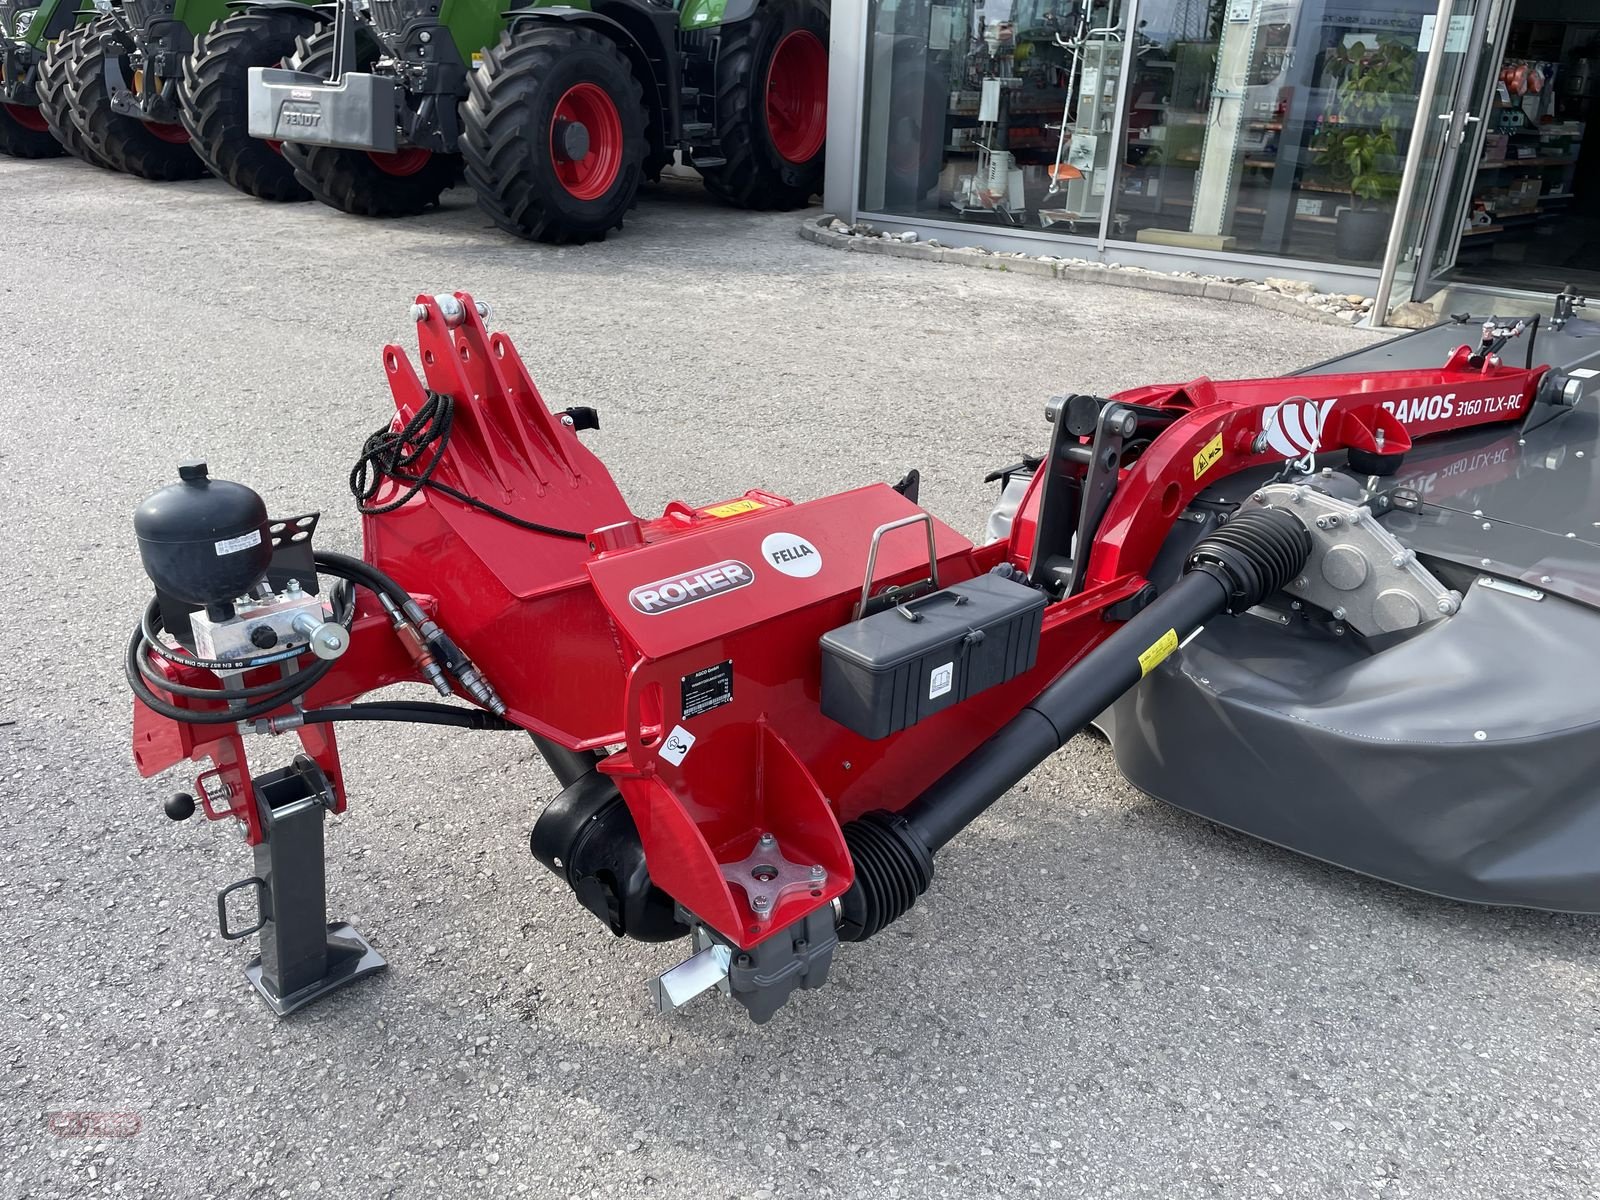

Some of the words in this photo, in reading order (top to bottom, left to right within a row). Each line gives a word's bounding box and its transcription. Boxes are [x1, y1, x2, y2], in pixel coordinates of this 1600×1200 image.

[283, 111, 321, 127] FENDT
[1456, 400, 1482, 417] 3160
[1484, 393, 1523, 413] TLX-RC
[771, 544, 814, 564] FELLA
[634, 564, 750, 611] ROHER
